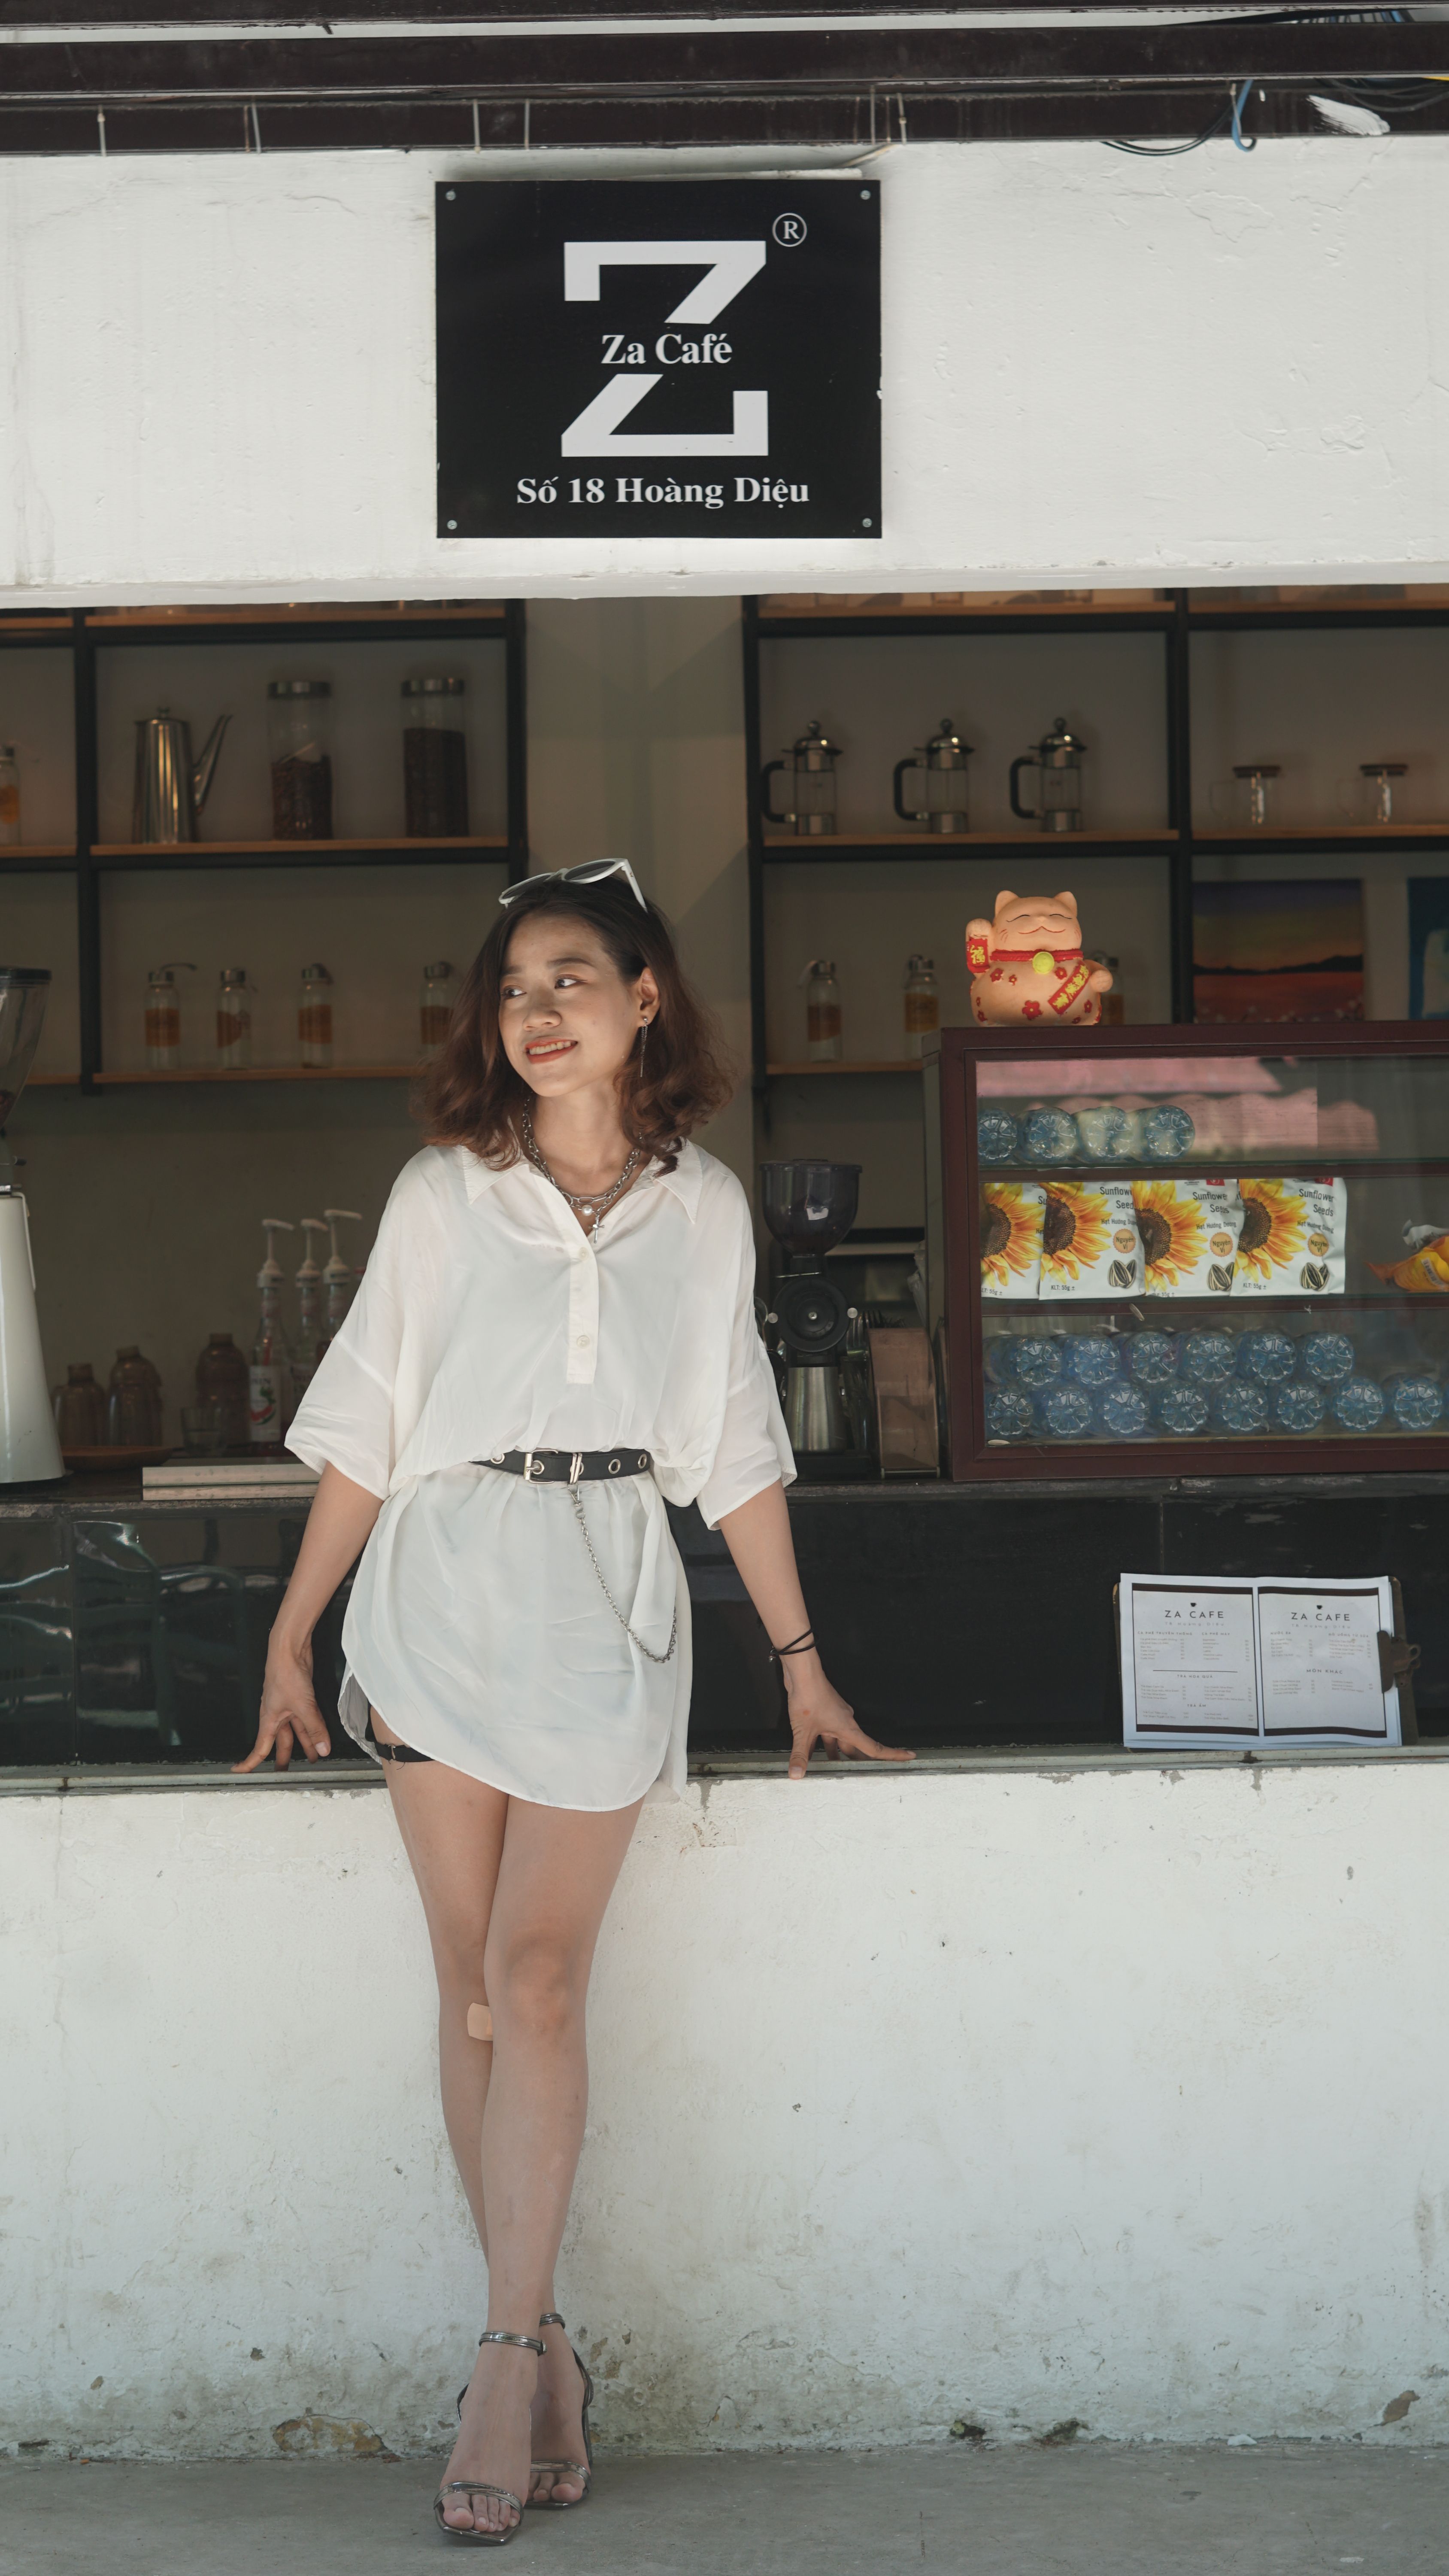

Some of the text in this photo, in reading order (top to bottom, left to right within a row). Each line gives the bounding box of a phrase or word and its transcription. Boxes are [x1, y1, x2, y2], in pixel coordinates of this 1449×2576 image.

[600, 333, 733, 364] Za Café
[517, 476, 809, 509] Số 18 Hoàng Diệu
[1100, 1187, 1132, 1195] Sunflow
[1299, 1189, 1334, 1203] Sunflower
[1116, 1200, 1134, 1209] Seed
[1313, 1204, 1334, 1216] Seeds
[1164, 1610, 1224, 1619] ZA CAFE
[1291, 1612, 1308, 1620] ZA
